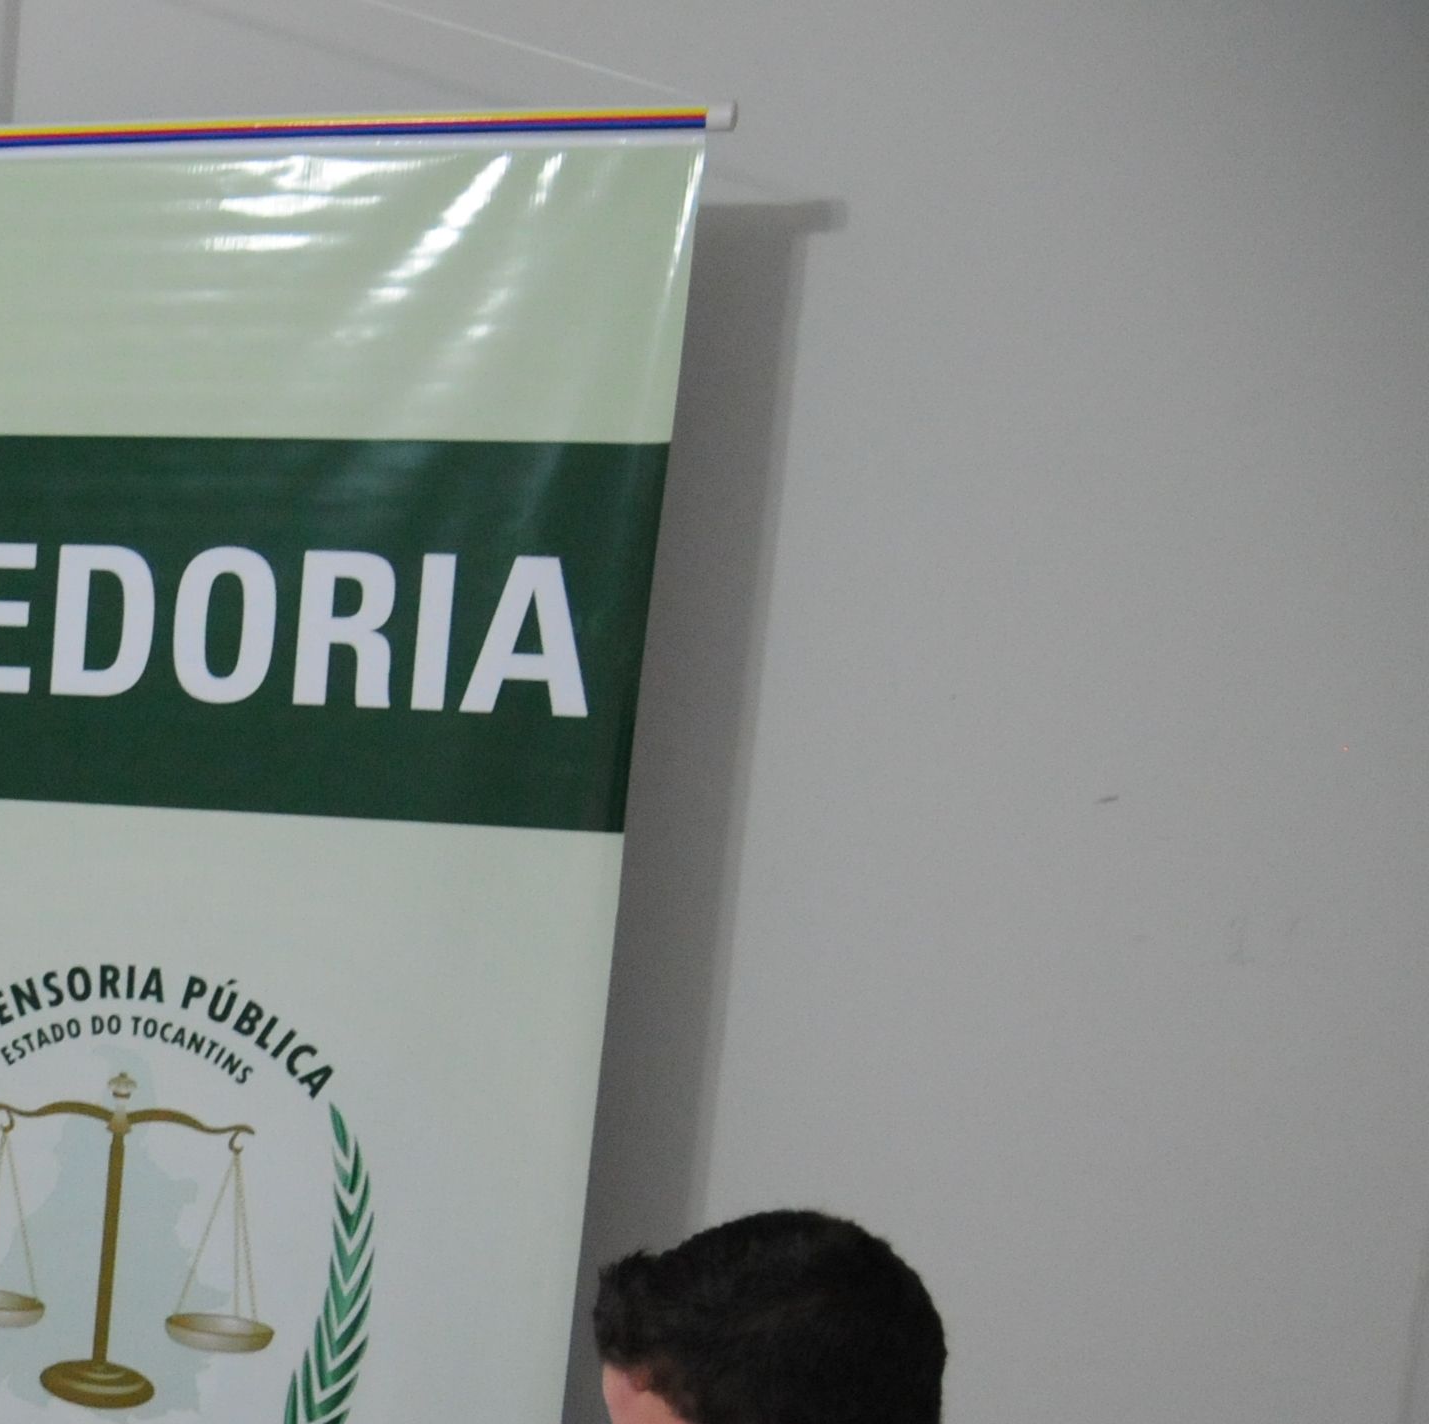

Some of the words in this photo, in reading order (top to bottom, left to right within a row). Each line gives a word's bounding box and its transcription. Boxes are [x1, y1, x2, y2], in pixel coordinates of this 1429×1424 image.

[0, 1017, 82, 1066] ESTADO
[91, 1014, 122, 1036] DO
[130, 1015, 255, 1085] TOCANTINS
[181, 975, 335, 1100] PÚBLICA
